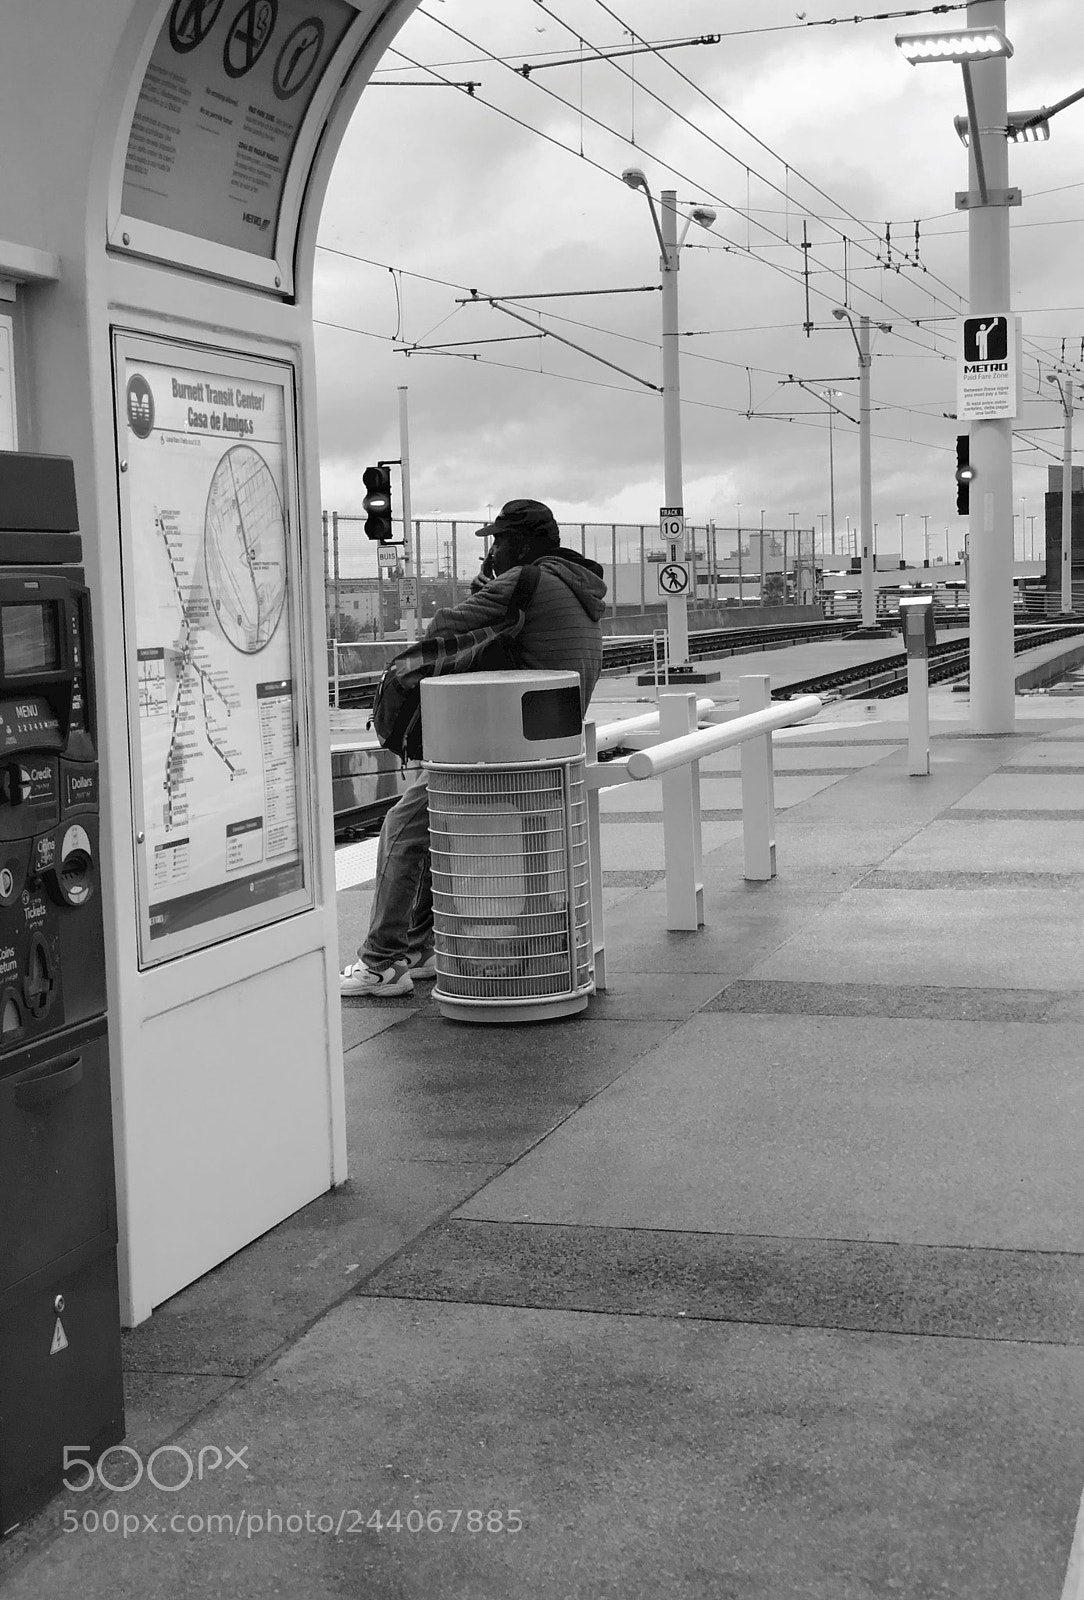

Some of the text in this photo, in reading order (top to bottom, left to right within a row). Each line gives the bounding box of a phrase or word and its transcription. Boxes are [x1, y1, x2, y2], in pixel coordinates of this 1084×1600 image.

[964, 363, 1008, 374] METRO
[171, 377, 204, 402] Burnett
[205, 384, 235, 407] Transit
[187, 406, 254, 437] Casa de Amigos
[664, 522, 680, 534] 10
[15, 704, 38, 718] MENU
[31, 766, 52, 781] Credit
[71, 776, 93, 790] Dollars
[23, 903, 46, 920] Tickets
[0, 960, 17, 974] eturn
